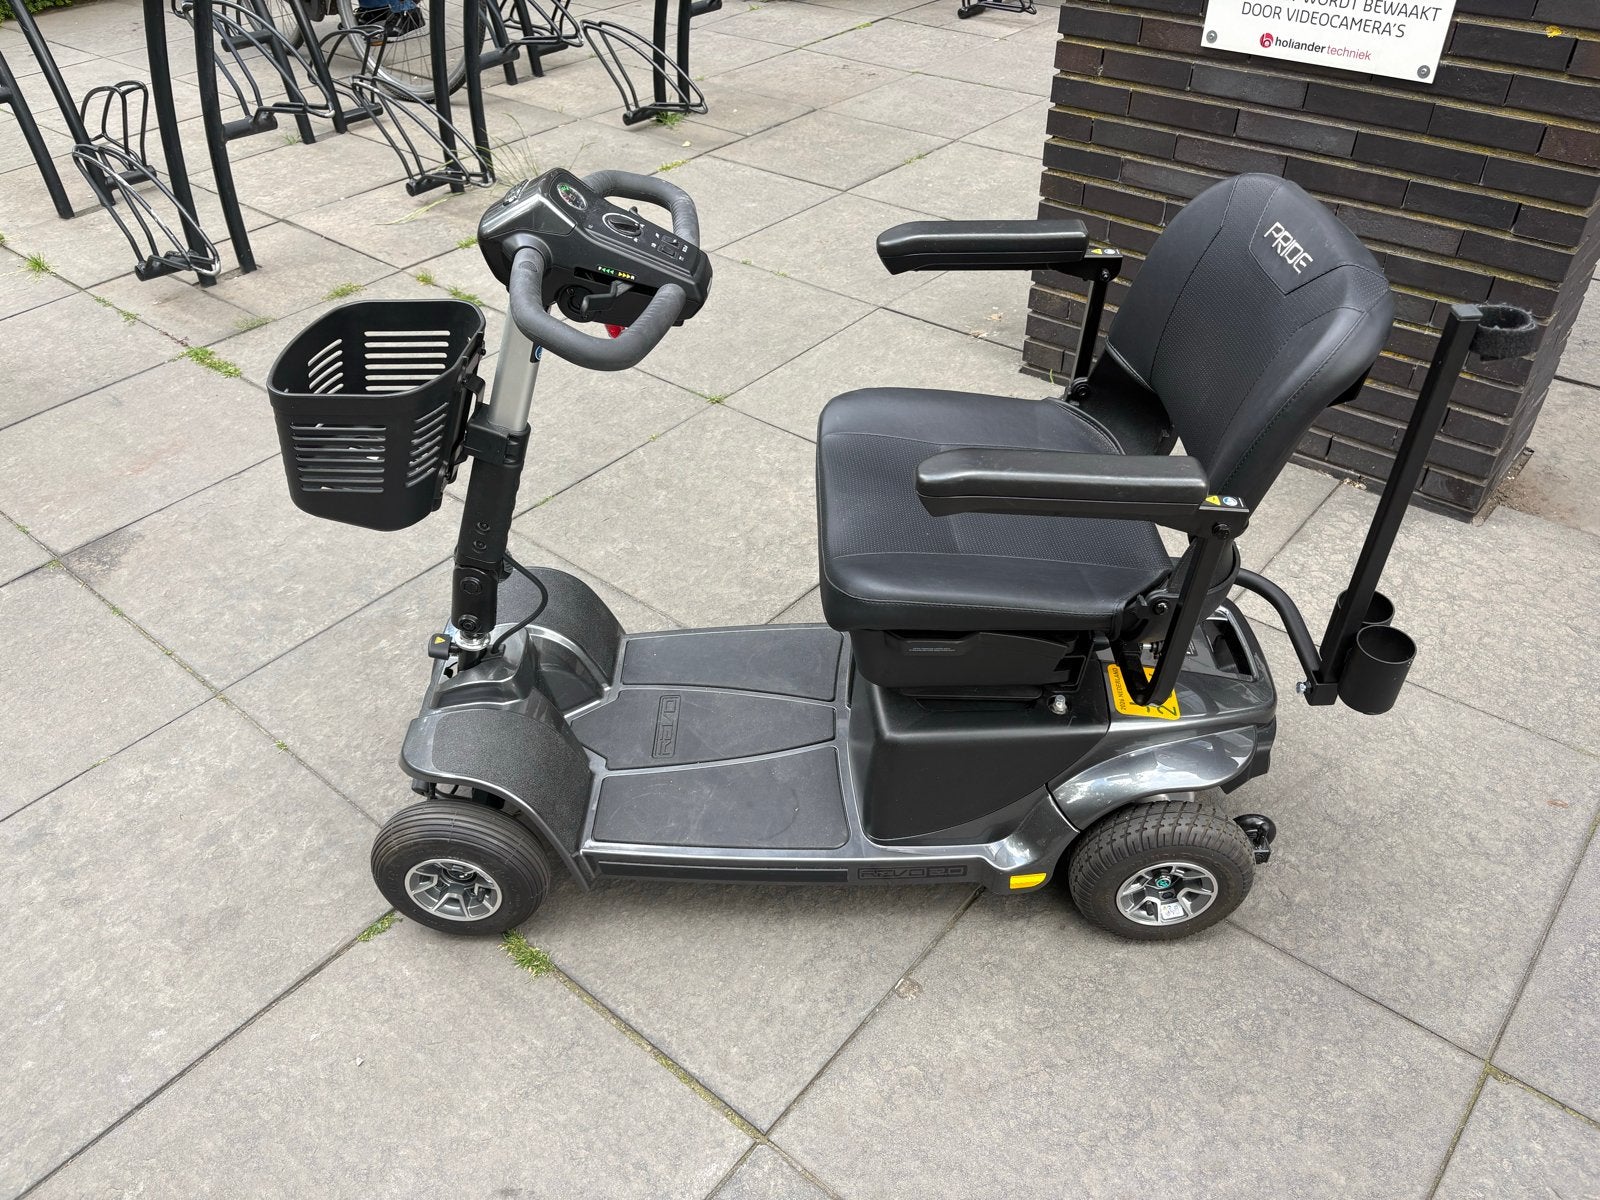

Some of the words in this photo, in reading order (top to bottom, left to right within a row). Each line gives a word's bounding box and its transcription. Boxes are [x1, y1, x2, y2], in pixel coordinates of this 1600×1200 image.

[1241, 1, 1282, 20] DOOR
[1287, 7, 1406, 38] VIDEOCAMERA'S
[1363, 0, 1442, 21] BEWAAKT
[1327, 44, 1372, 61] techniek
[1263, 221, 1314, 274] PRIDE
[1112, 667, 1124, 698] NEDERLAND
[859, 867, 927, 879] REVO
